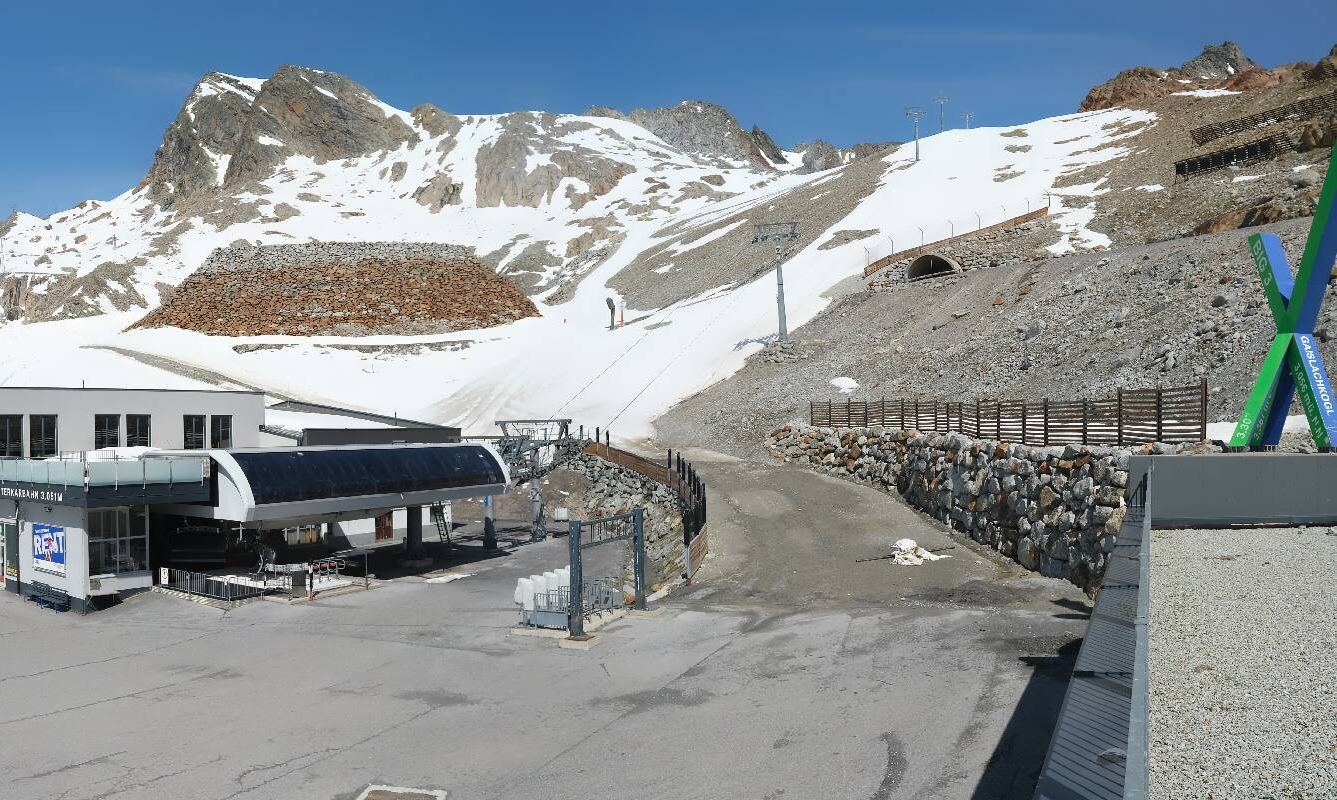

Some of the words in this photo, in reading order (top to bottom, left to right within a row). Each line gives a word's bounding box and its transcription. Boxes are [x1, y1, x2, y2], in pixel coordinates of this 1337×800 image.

[1253, 239, 1267, 272] BIG
[1264, 272, 1272, 286] 3
[1301, 336, 1334, 416] GAISLACHKOGL
[1236, 414, 1252, 439] 3.30
[33, 532, 65, 556] RENT
